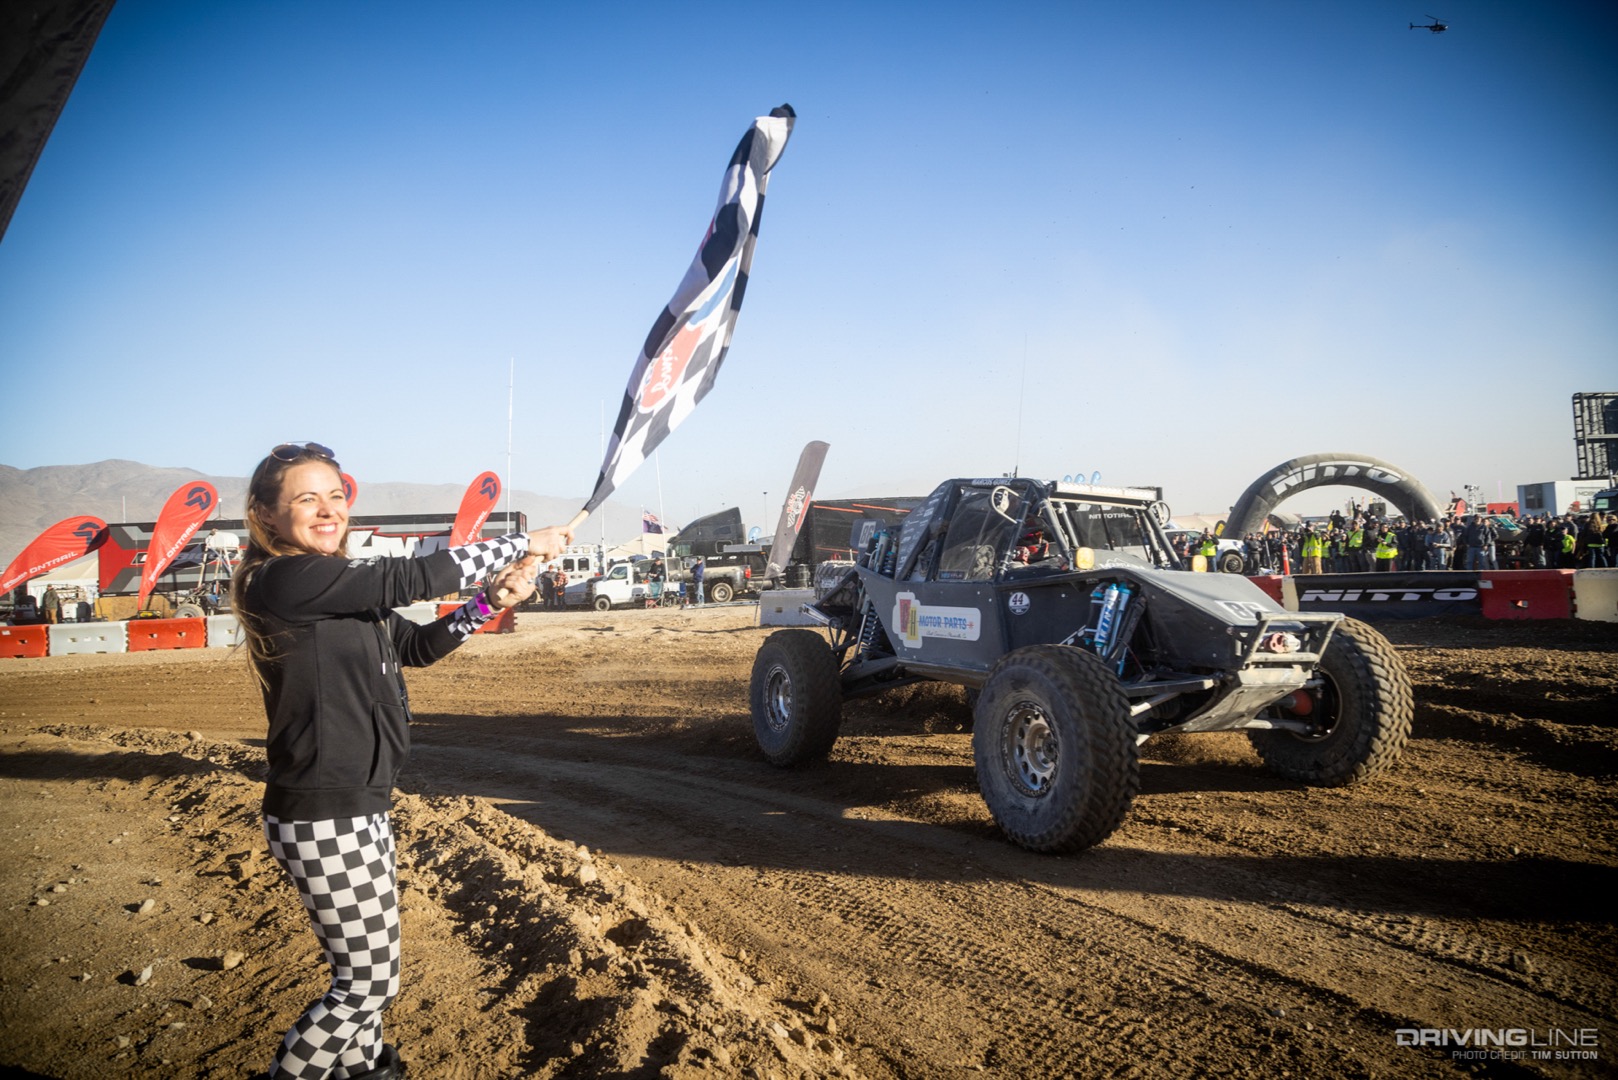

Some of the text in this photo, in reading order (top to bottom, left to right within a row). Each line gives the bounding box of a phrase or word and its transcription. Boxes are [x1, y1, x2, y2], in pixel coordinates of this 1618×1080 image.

[1270, 461, 1402, 496] NITTO
[467, 511, 488, 541] ONTRAIL
[166, 522, 199, 558] ONTRAIL
[29, 552, 78, 574] ONTRAIL
[1012, 594, 1024, 605] 44
[1300, 588, 1478, 602] NITTO
[918, 615, 942, 628] MOTOR
[943, 616, 967, 630] PARTS
